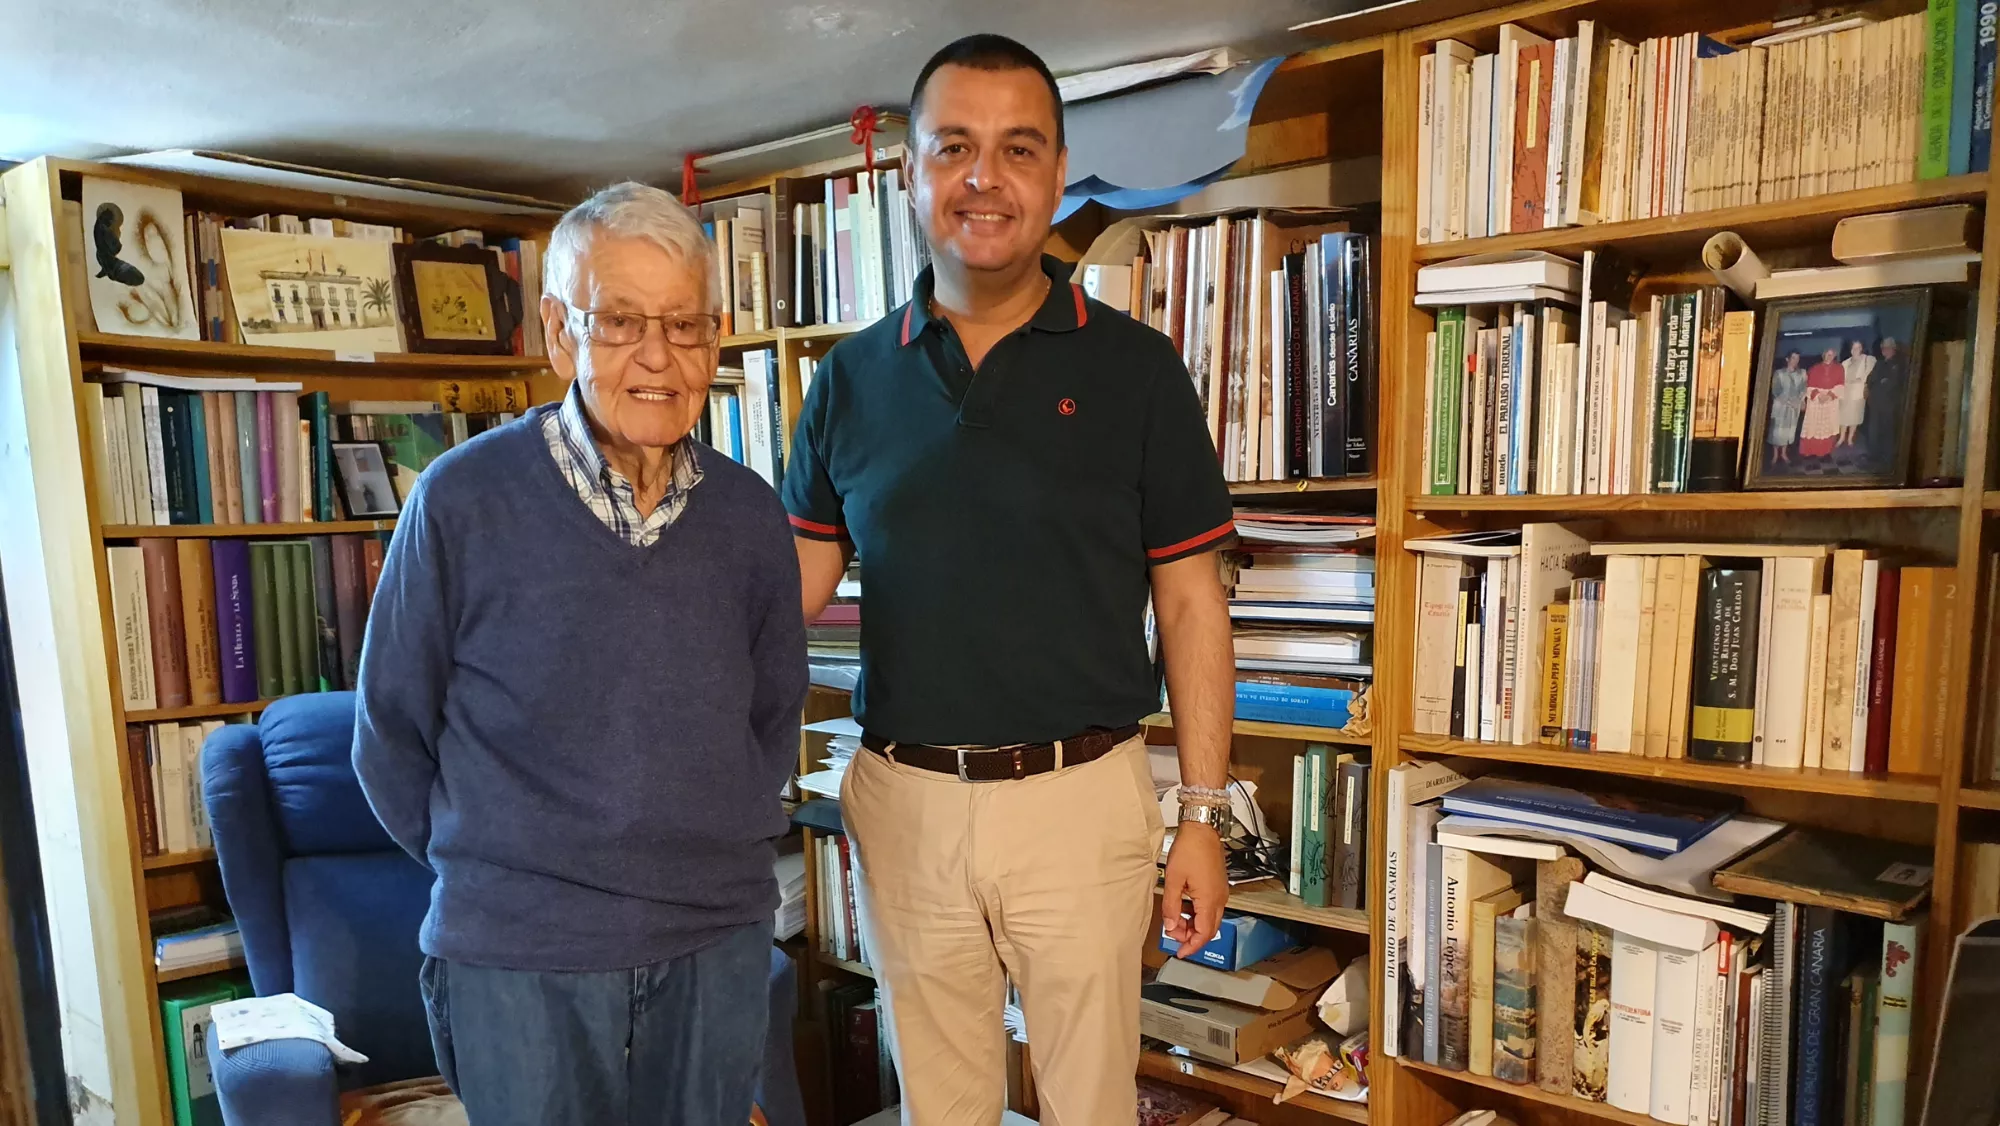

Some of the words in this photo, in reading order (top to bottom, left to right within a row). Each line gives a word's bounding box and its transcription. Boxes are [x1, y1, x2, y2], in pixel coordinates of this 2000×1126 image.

[1980, 2, 1998, 47] 1990
[1975, 86, 1984, 97] de
[1931, 108, 1943, 119] DE
[1973, 98, 1984, 131] Agenda
[1928, 124, 1943, 162] AGENDA
[1291, 274, 1300, 324] CANARIAS
[1329, 303, 1337, 322] cielo
[1292, 326, 1300, 340] DE
[1329, 323, 1336, 331] el
[1667, 314, 1678, 346] marcha
[1329, 332, 1337, 358] desde
[1348, 318, 1358, 382] CANARIAS
[1501, 333, 1511, 381] TERRENAL
[1677, 349, 1689, 358] la
[1665, 348, 1678, 372] larga
[1676, 359, 1687, 382] hacia
[1327, 359, 1337, 406] Canarias
[1664, 373, 1675, 382] La
[1661, 387, 1674, 430] LAUREANO
[1293, 398, 1302, 457] PATRIMONIO
[1499, 424, 1508, 434] EL
[1540, 555, 1559, 572] HACIA
[229, 574, 240, 601] SENDA
[1946, 584, 1956, 599] 2
[233, 602, 240, 612] LA
[1724, 606, 1732, 617] DE
[1732, 590, 1743, 623] CARLOS
[232, 622, 243, 655] HUELLA
[1552, 628, 1561, 659] MONAGAS
[1720, 620, 1731, 659] REINADO
[1731, 626, 1740, 648] JUAN
[235, 656, 244, 668] LA
[1709, 624, 1721, 681] VEINTICINCO
[1729, 652, 1739, 671] DON
[1549, 662, 1560, 680] PEPE
[1721, 661, 1729, 674] DE
[129, 665, 139, 701] ESTUDIOS
[1728, 674, 1739, 686] M.
[1548, 685, 1557, 723] MEMORIAS
[1727, 690, 1737, 699] S.
[1425, 776, 1445, 788] DIARIO
[1387, 851, 1397, 911] CANARIAS
[1447, 876, 1459, 931] Antonio
[1387, 916, 1397, 932] DE
[1204, 950, 1225, 960] NOKIA
[1387, 937, 1397, 979] DIARIO
[1446, 936, 1459, 979] López
[1810, 928, 1826, 986] CANARIA
[1808, 989, 1821, 1026] GRAN
[1808, 1029, 1820, 1045] DE
[1182, 1064, 1188, 1073] 3
[1804, 1048, 1818, 1095] PALMAS
[1803, 1097, 1814, 1118] LAS
